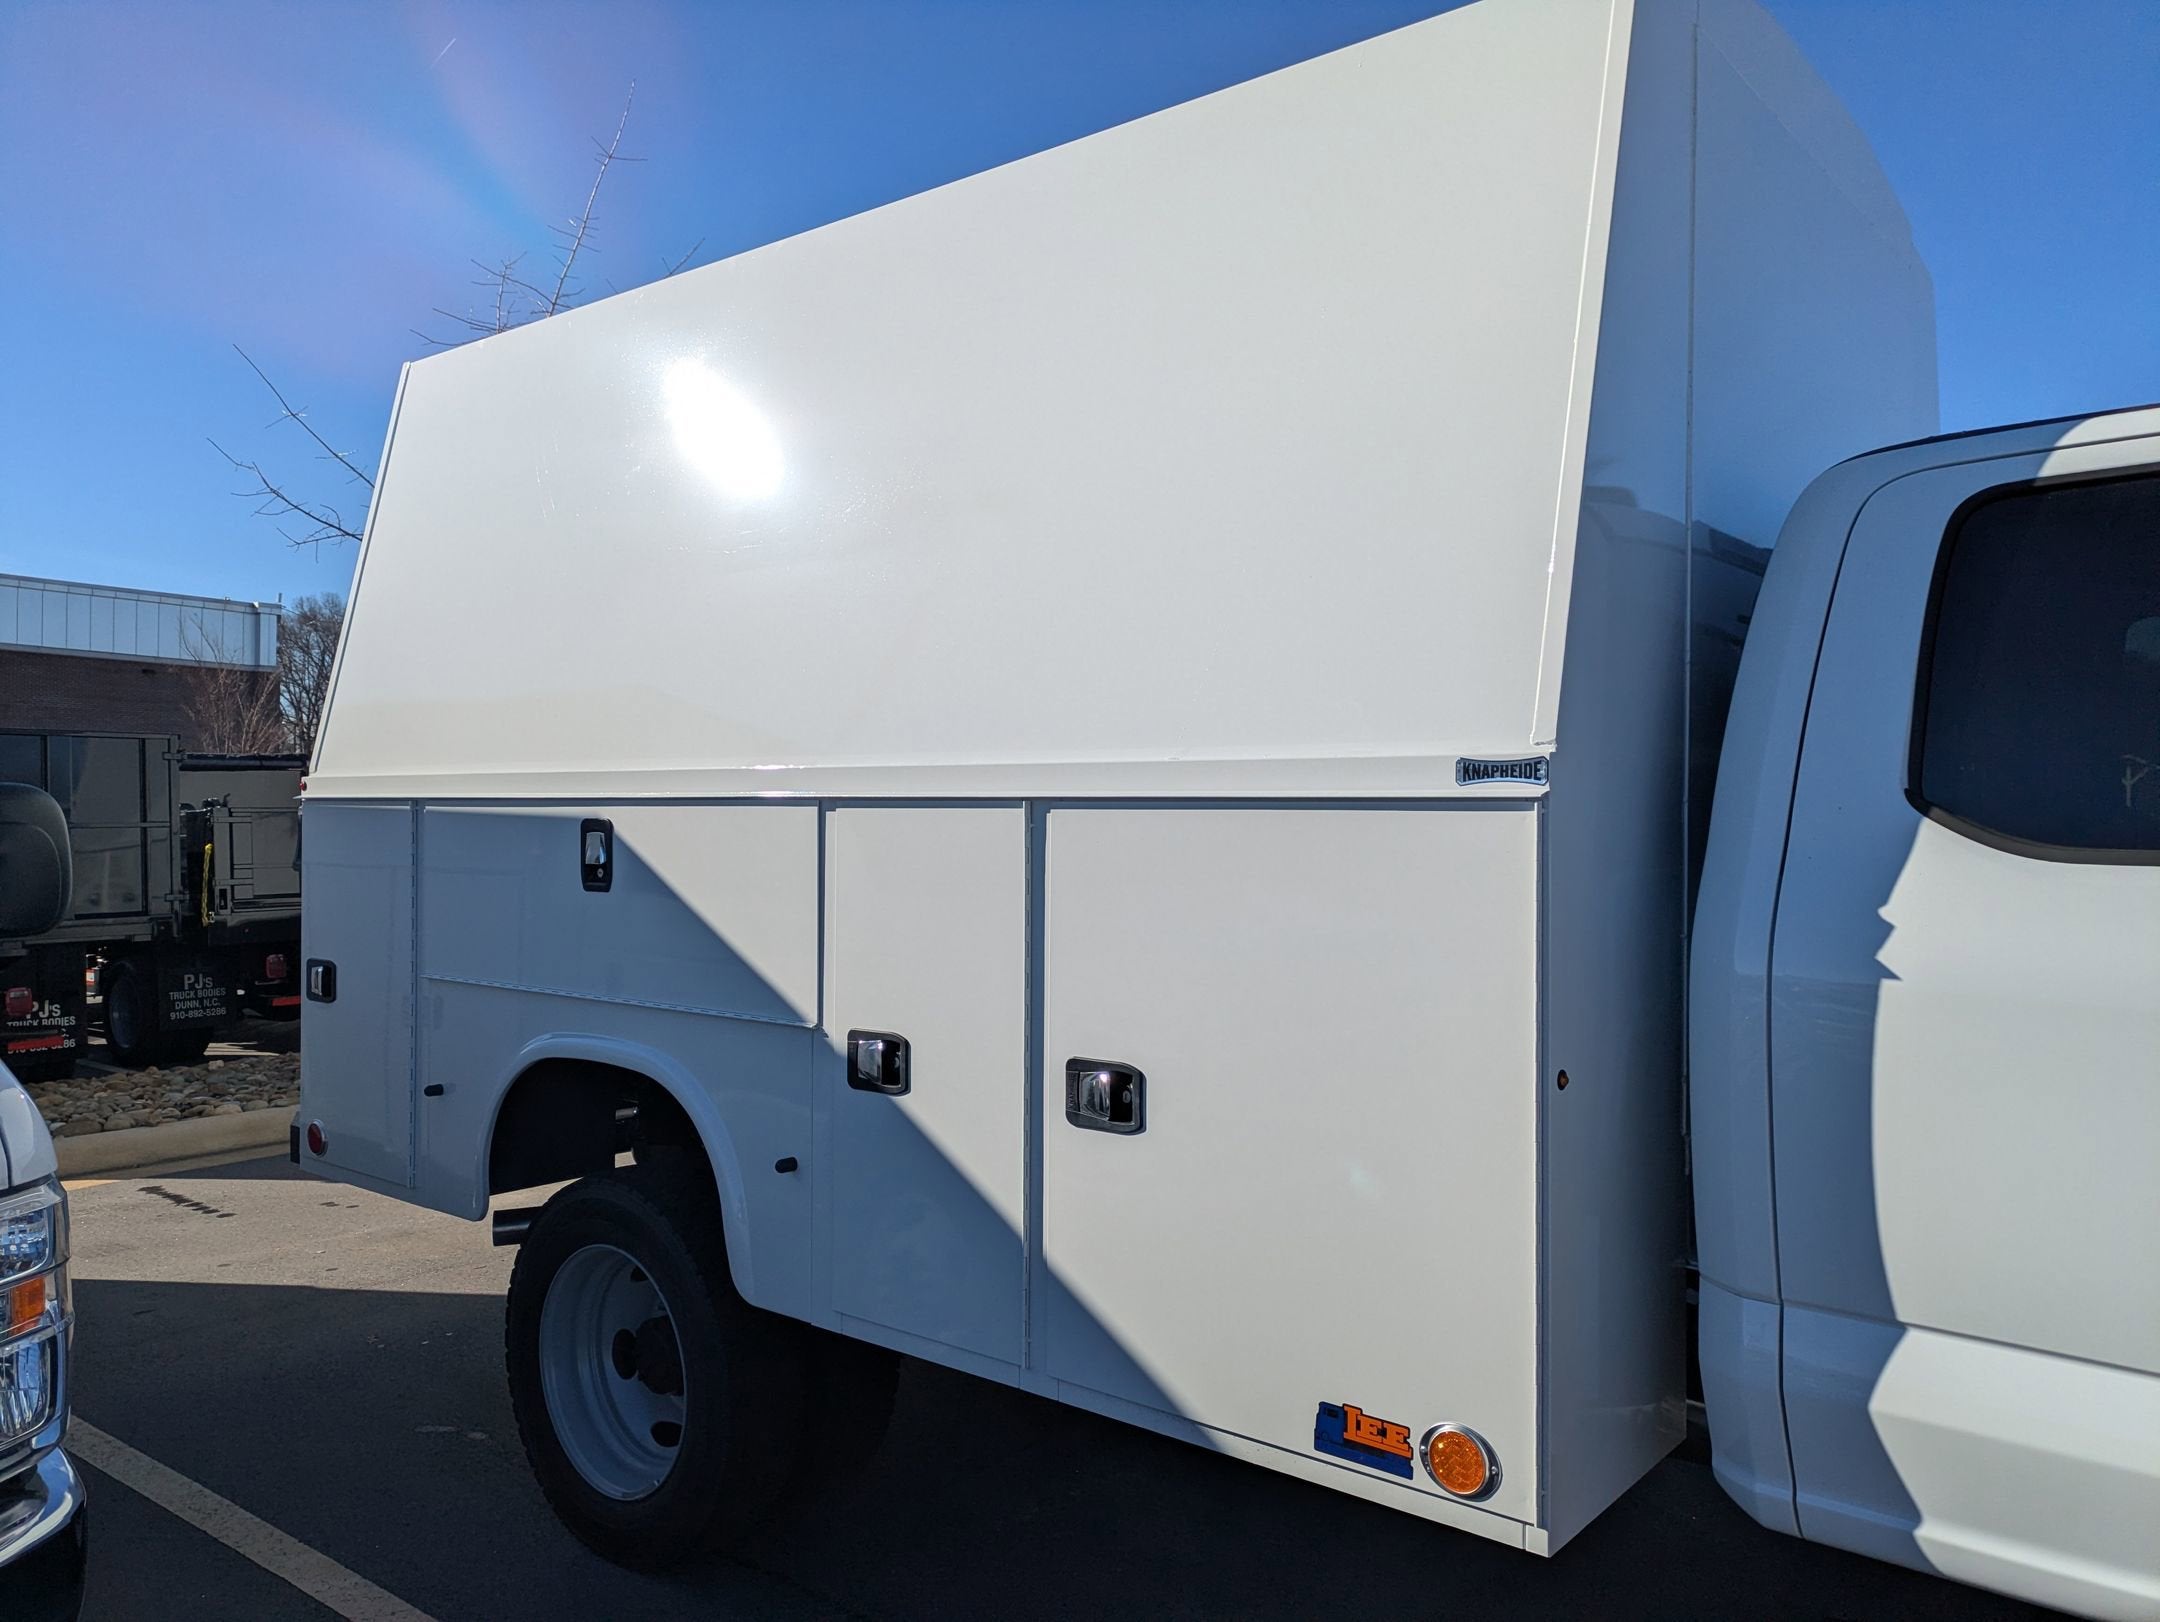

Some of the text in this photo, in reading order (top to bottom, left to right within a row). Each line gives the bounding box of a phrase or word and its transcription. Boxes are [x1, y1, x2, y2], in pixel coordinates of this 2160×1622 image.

[1462, 760, 1542, 782] KNAPHEIDE
[168, 987, 226, 1001] TRUCK BODIES
[175, 998, 221, 1010] DUNN, N.C.
[170, 1007, 227, 1020] 910-892-5286
[1343, 1404, 1413, 1459] LEE
